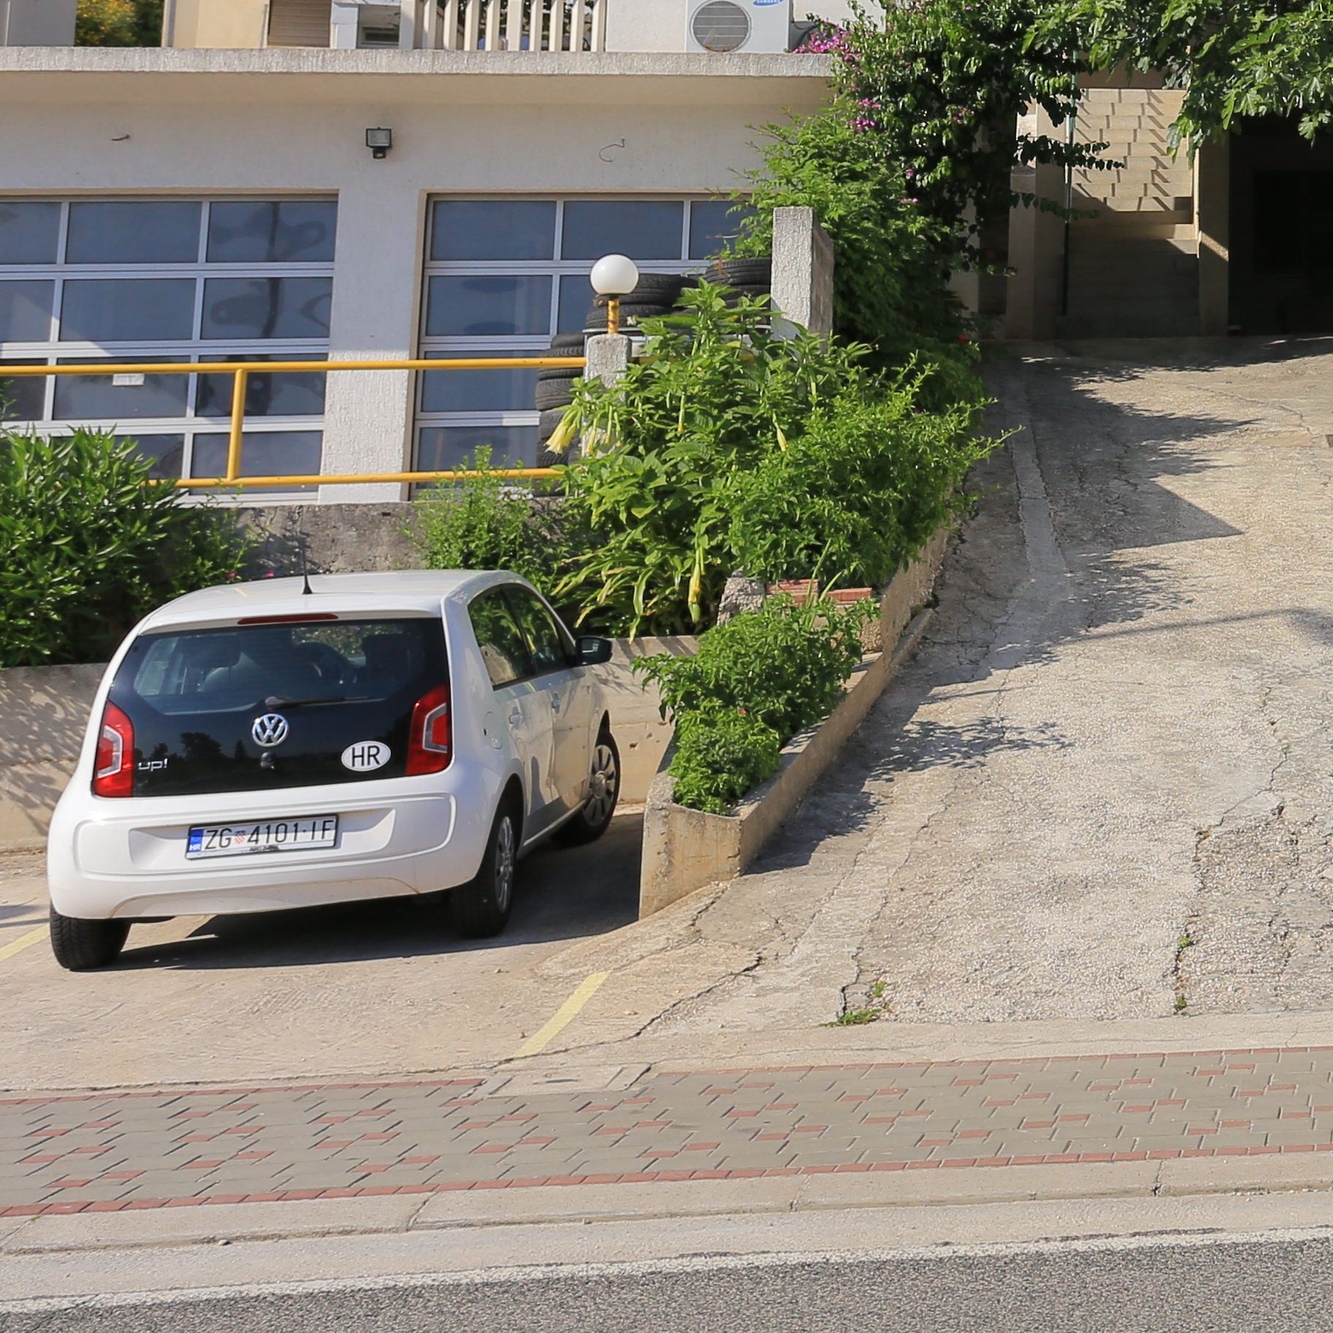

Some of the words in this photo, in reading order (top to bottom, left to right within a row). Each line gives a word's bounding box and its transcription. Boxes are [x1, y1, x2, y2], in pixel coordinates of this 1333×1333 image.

[138, 758, 168, 772] up!
[352, 745, 381, 767] HR
[205, 827, 232, 850] ZG
